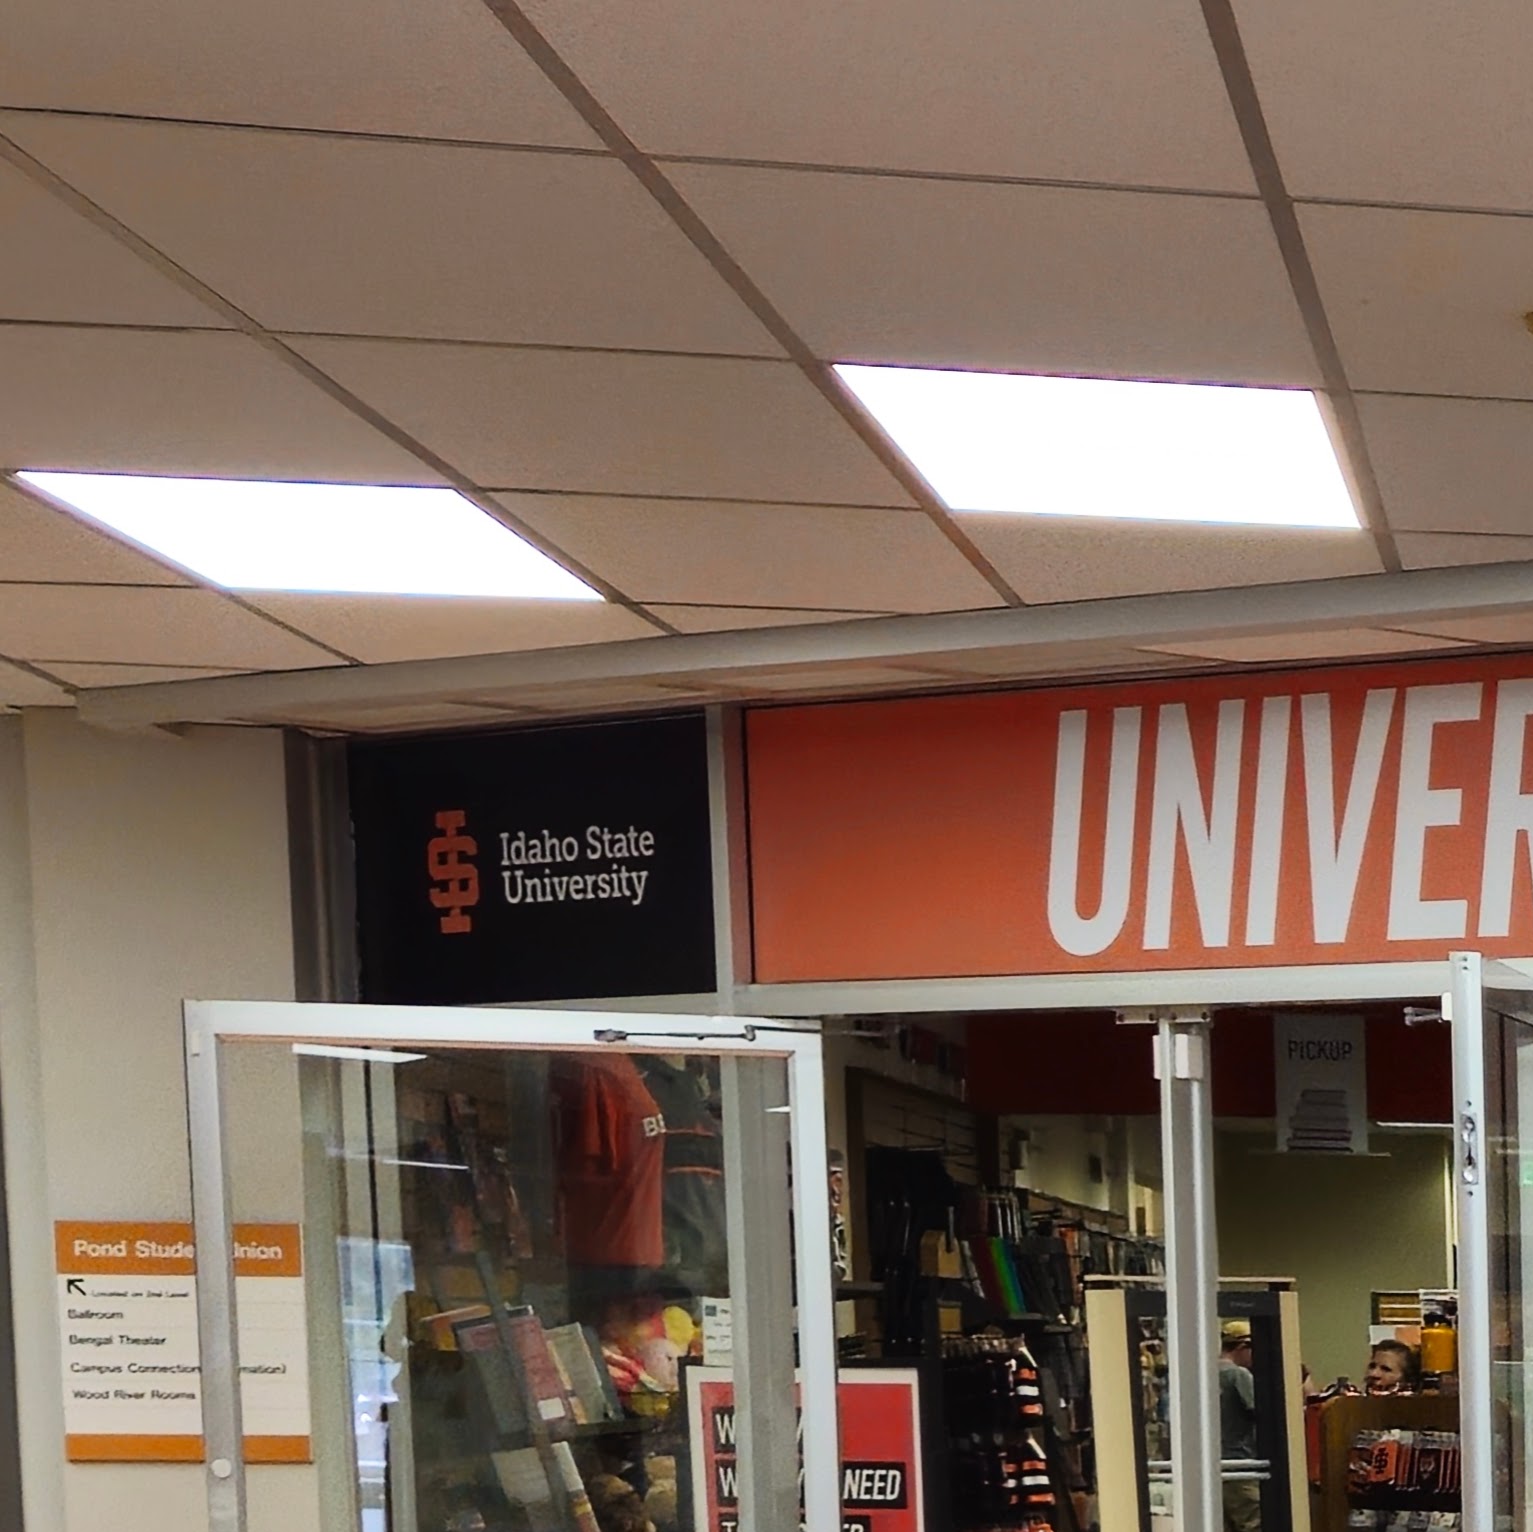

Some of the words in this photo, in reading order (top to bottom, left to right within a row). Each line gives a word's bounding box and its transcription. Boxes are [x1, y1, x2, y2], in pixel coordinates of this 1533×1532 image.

[499, 829, 579, 866] Idaho
[585, 825, 655, 861] State
[502, 864, 649, 905] University
[1288, 1040, 1352, 1060] PICKUP
[73, 1239, 128, 1258] Pond
[134, 1240, 195, 1259] Stude
[69, 1334, 114, 1347] Bengal
[70, 1362, 123, 1375] Campus
[842, 1469, 902, 1501] NEED
